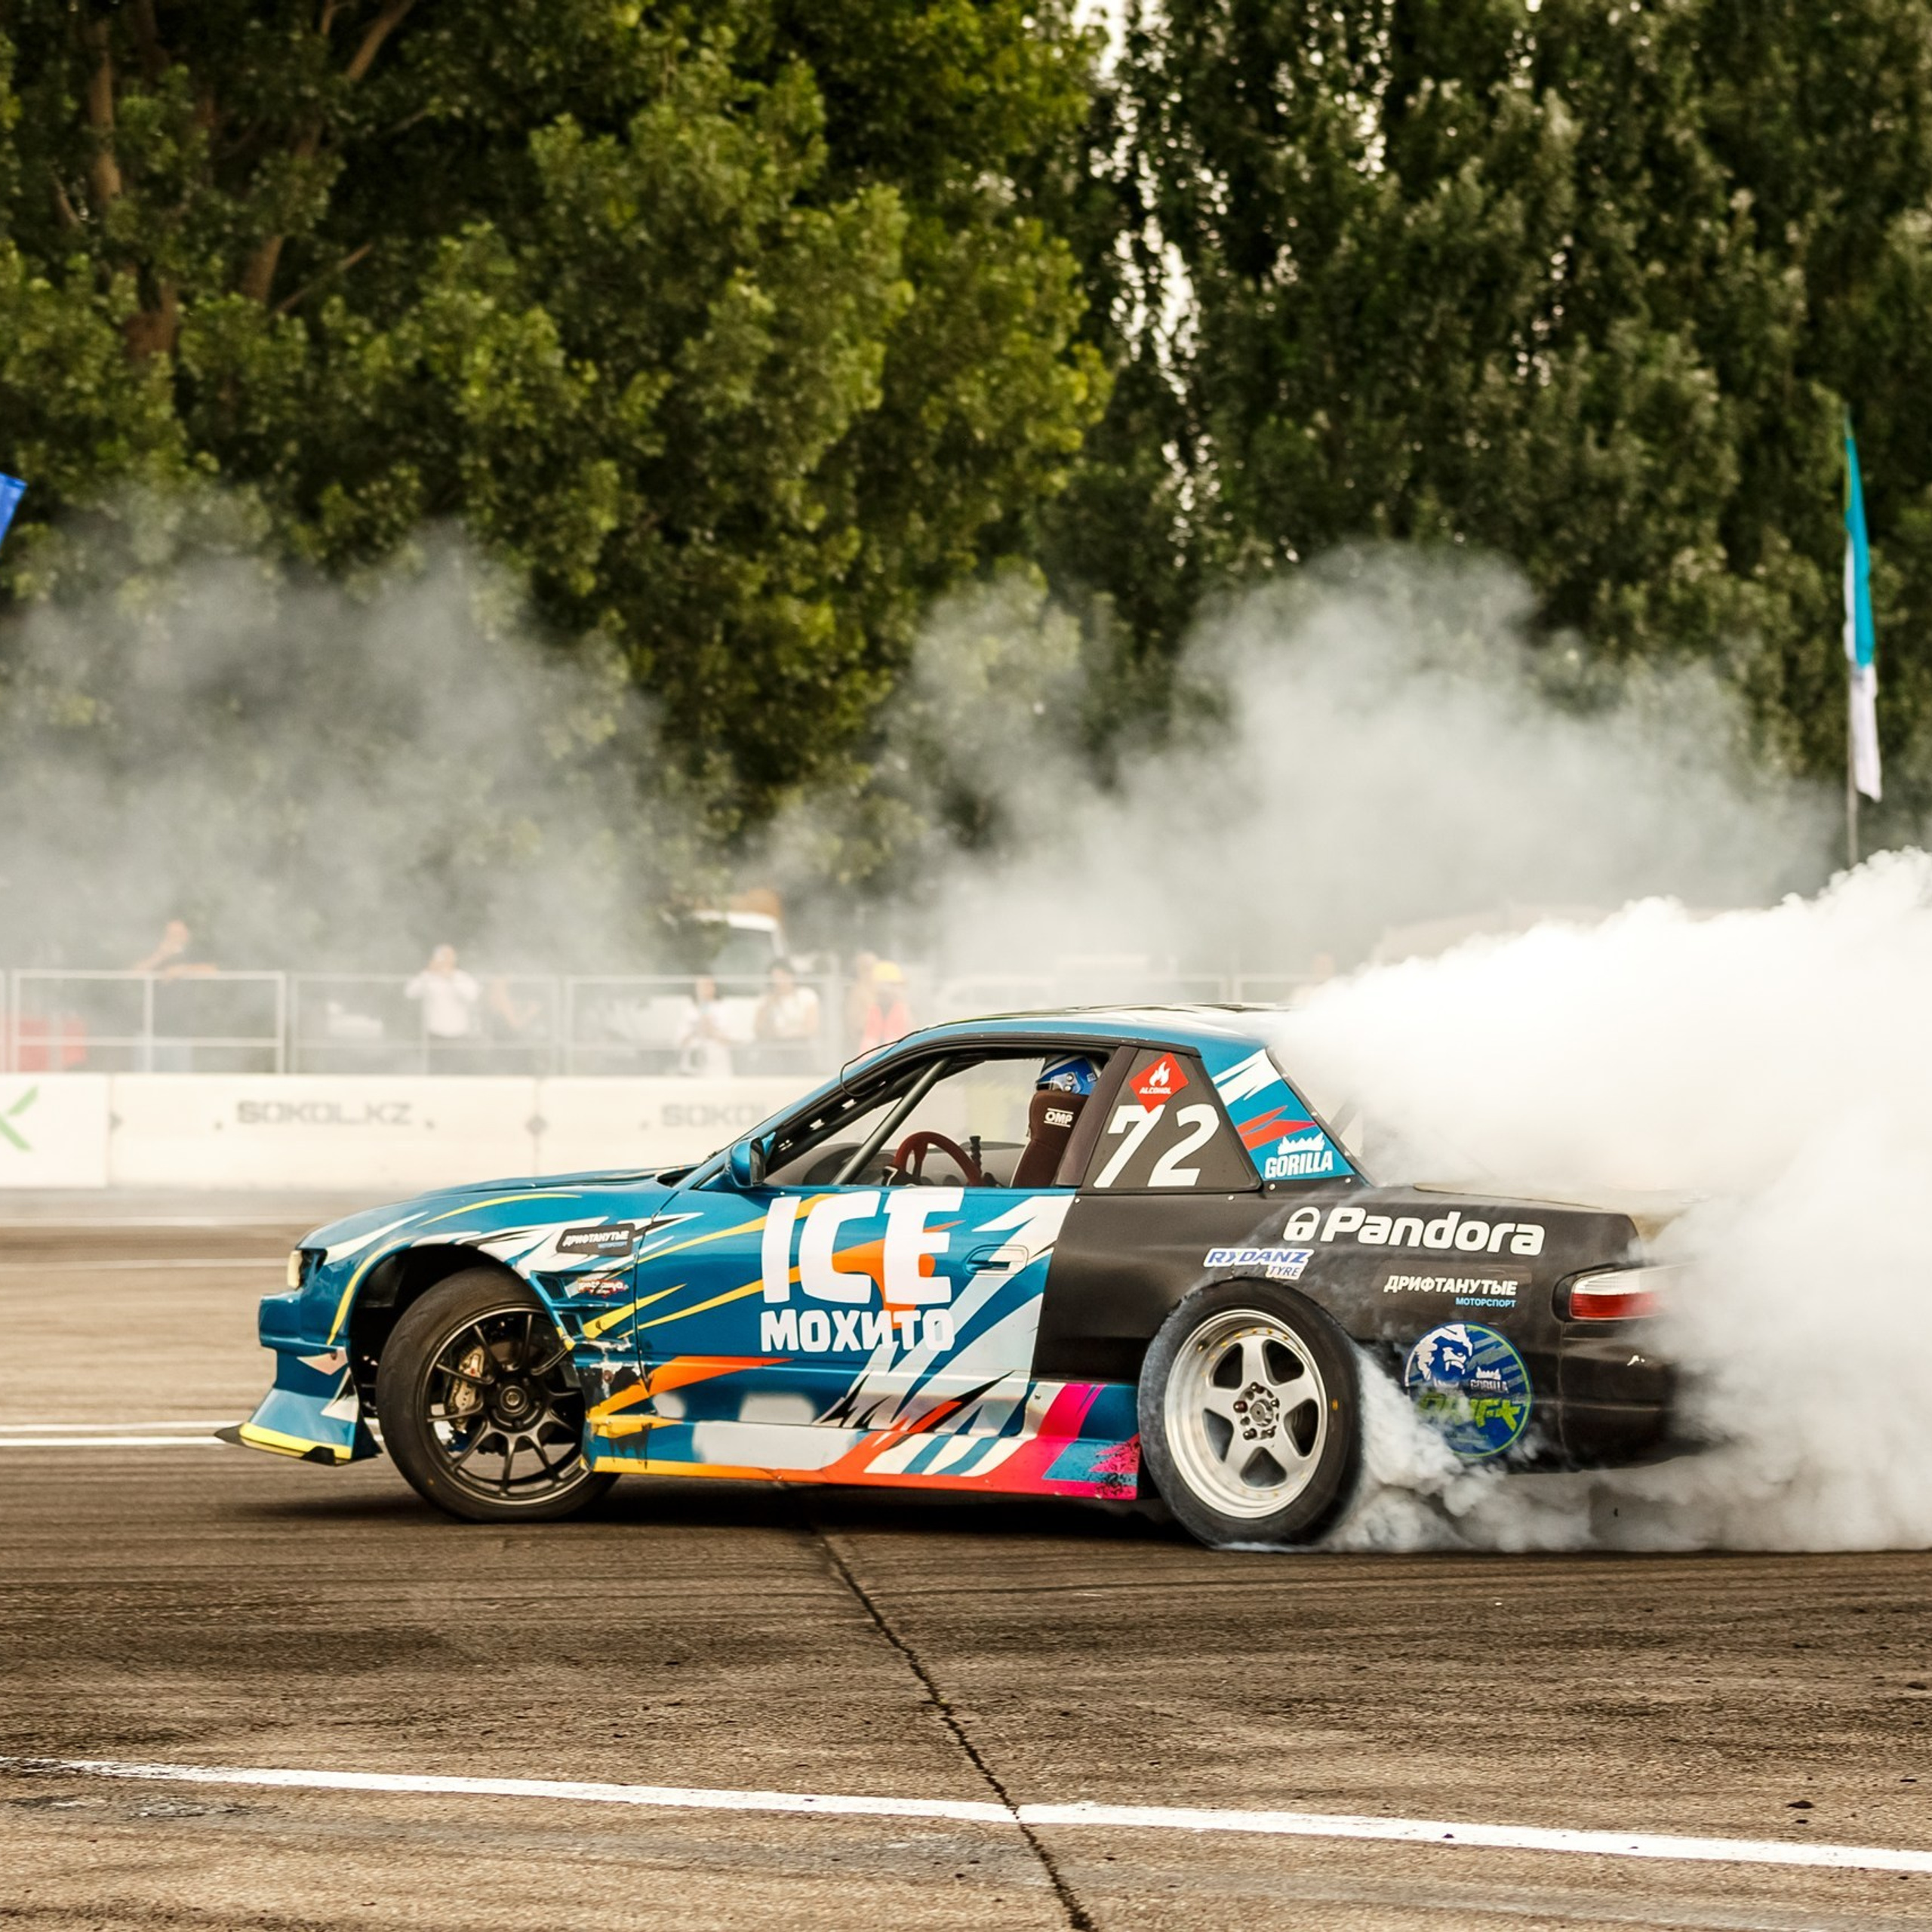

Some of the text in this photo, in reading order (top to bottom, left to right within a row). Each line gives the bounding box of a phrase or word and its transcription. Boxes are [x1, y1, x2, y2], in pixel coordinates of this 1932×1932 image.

[1044, 1111, 1073, 1124] OMP
[1094, 1104, 1220, 1188] 72
[1265, 1151, 1334, 1179] GORILLA
[761, 1187, 964, 1304] ICE
[1320, 1208, 1546, 1256] Pandora
[1269, 1266, 1301, 1277] TYRE
[1383, 1275, 1518, 1296] ДРИФТАНУТЫЕ
[1455, 1297, 1517, 1308] МОТОРСПОРТ
[761, 1309, 955, 1352] МОХИТО
